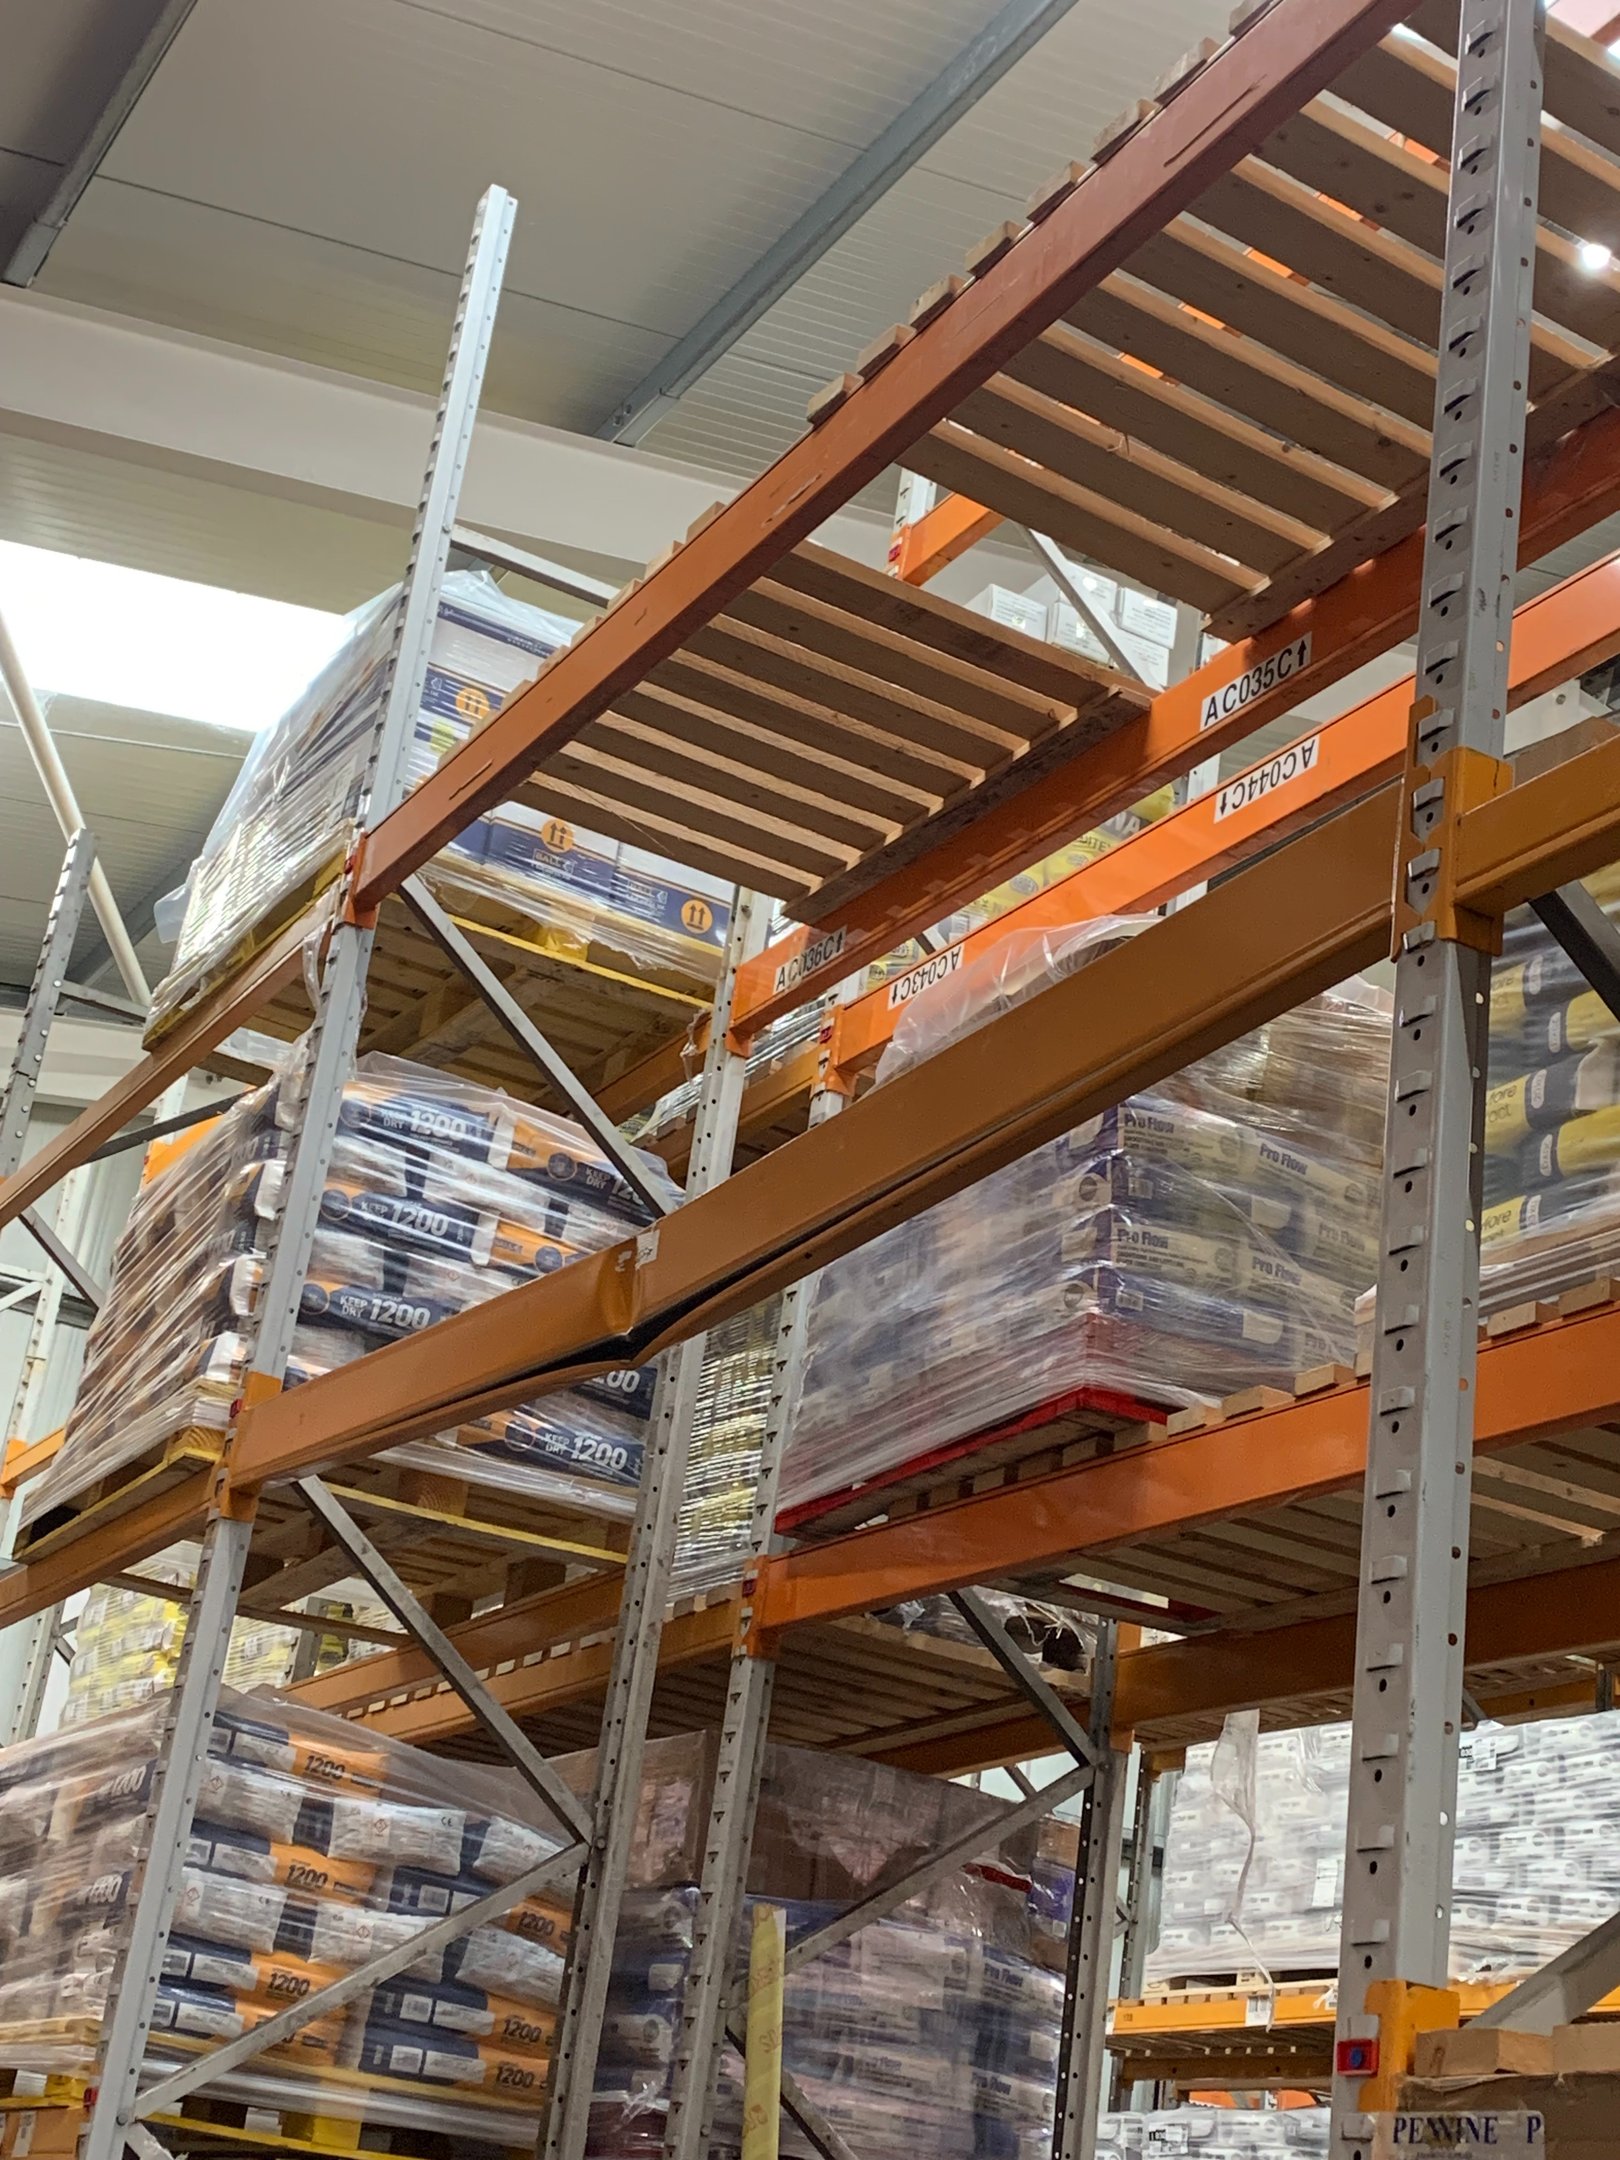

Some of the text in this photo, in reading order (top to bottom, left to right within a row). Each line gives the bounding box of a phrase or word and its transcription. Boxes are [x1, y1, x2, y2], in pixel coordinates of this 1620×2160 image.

[1204, 648, 1292, 726] AC035C
[1232, 739, 1315, 810] AC044C
[901, 946, 962, 1000] AC043C
[409, 1109, 467, 1140] 1200
[1259, 1143, 1309, 1176] Pro Flow
[391, 1203, 449, 1237] 1200
[1141, 1231, 1169, 1250] Flow
[1251, 1256, 1273, 1275] Pro
[340, 1295, 431, 1330] KEEP 1200
[341, 1305, 364, 1319] DRY
[570, 1436, 629, 1471] 1200
[304, 1755, 346, 1781] 1200
[287, 1864, 329, 1890] 1200
[518, 1911, 556, 1937] 1200
[268, 1972, 310, 1997] 1200
[503, 2018, 543, 2043] 1200
[496, 2065, 536, 2089] 1200
